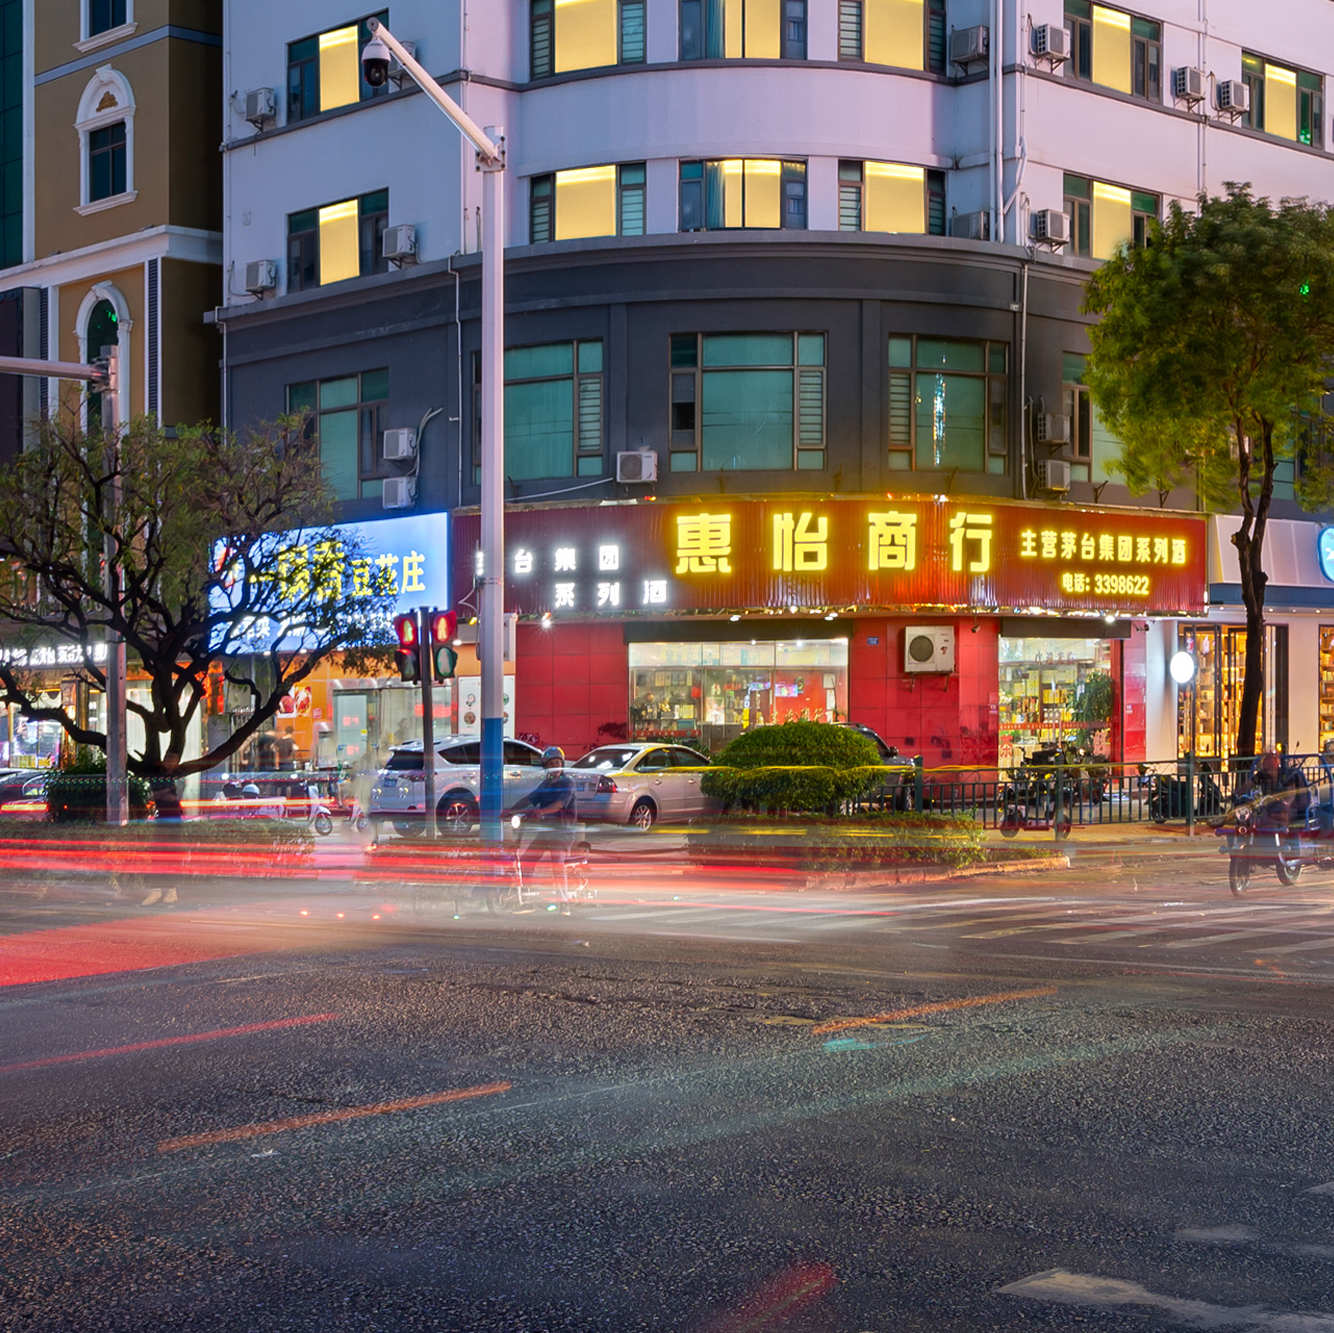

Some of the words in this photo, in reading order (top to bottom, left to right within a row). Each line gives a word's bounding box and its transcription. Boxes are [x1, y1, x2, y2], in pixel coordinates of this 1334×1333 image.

[675, 511, 993, 574] 惠怡商行
[1020, 529, 1187, 565] 主营茅台集团系列酒
[476, 544, 621, 575] 台集团
[555, 579, 668, 608] 系列酒
[1094, 573, 1150, 596] 3398622
